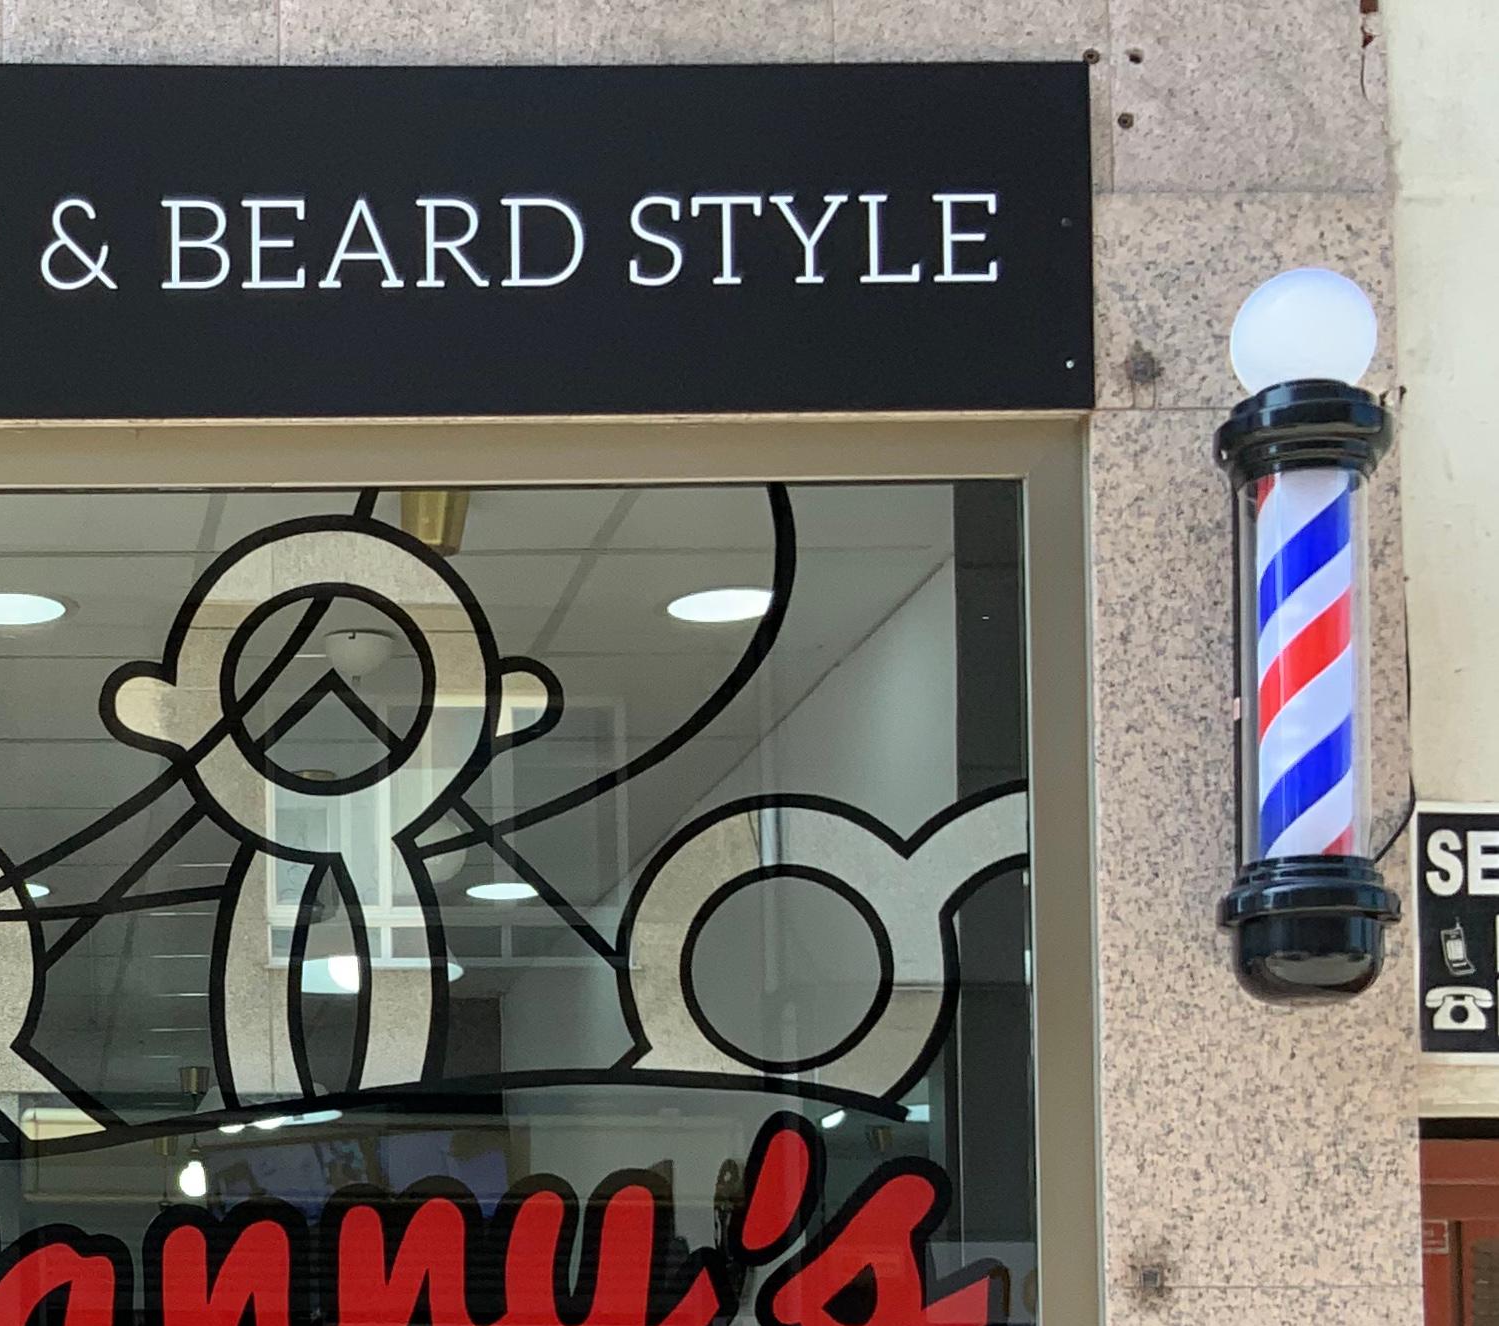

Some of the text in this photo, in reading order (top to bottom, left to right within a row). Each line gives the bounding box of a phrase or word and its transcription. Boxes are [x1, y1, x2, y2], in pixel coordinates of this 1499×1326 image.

[40, 198, 117, 290] &
[160, 197, 585, 289] BEARD
[629, 193, 998, 288] STYLE
